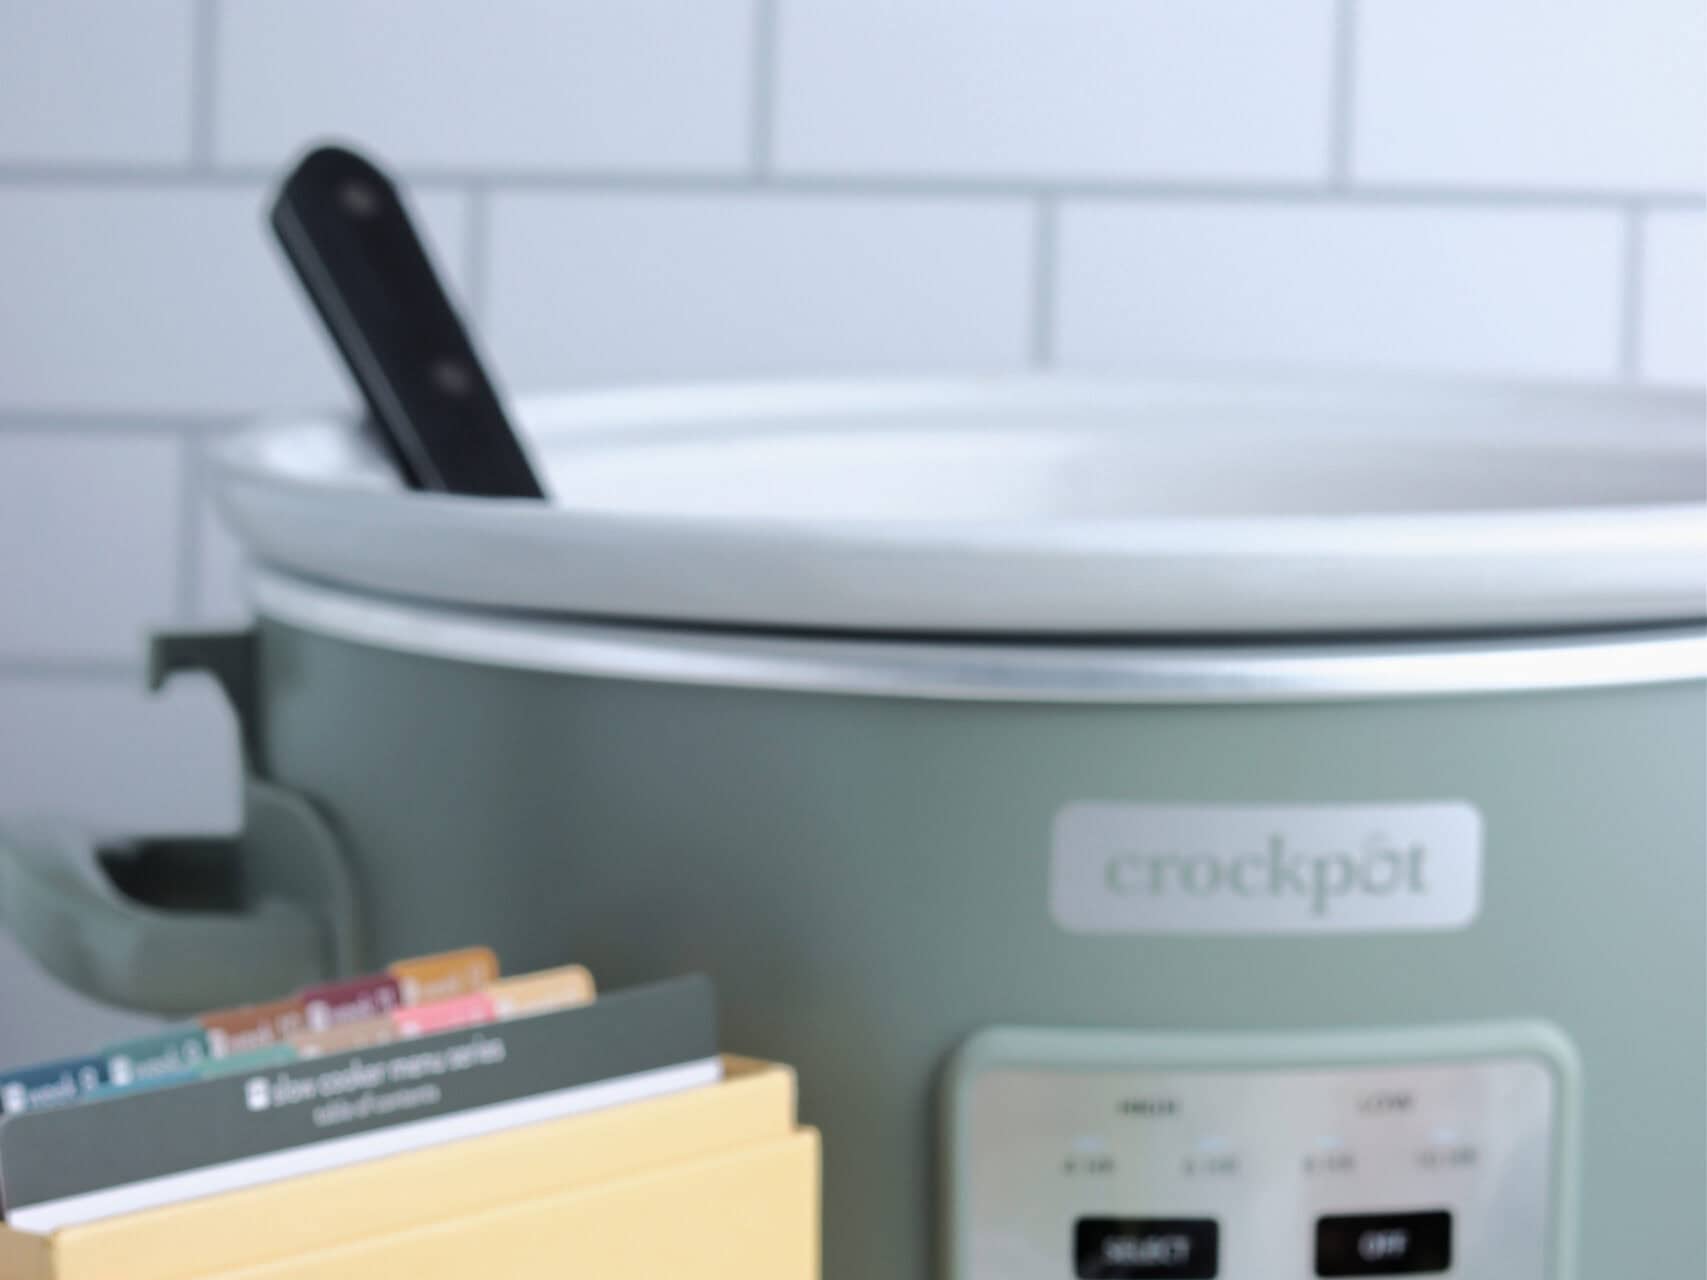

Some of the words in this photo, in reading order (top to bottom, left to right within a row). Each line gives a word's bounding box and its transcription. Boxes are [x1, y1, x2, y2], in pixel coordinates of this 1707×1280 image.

[1104, 830, 1428, 914] crockpot
[317, 1058, 385, 1096] cooker
[1103, 1234, 1191, 1266] SELECT
[1357, 1229, 1408, 1260] OFF
